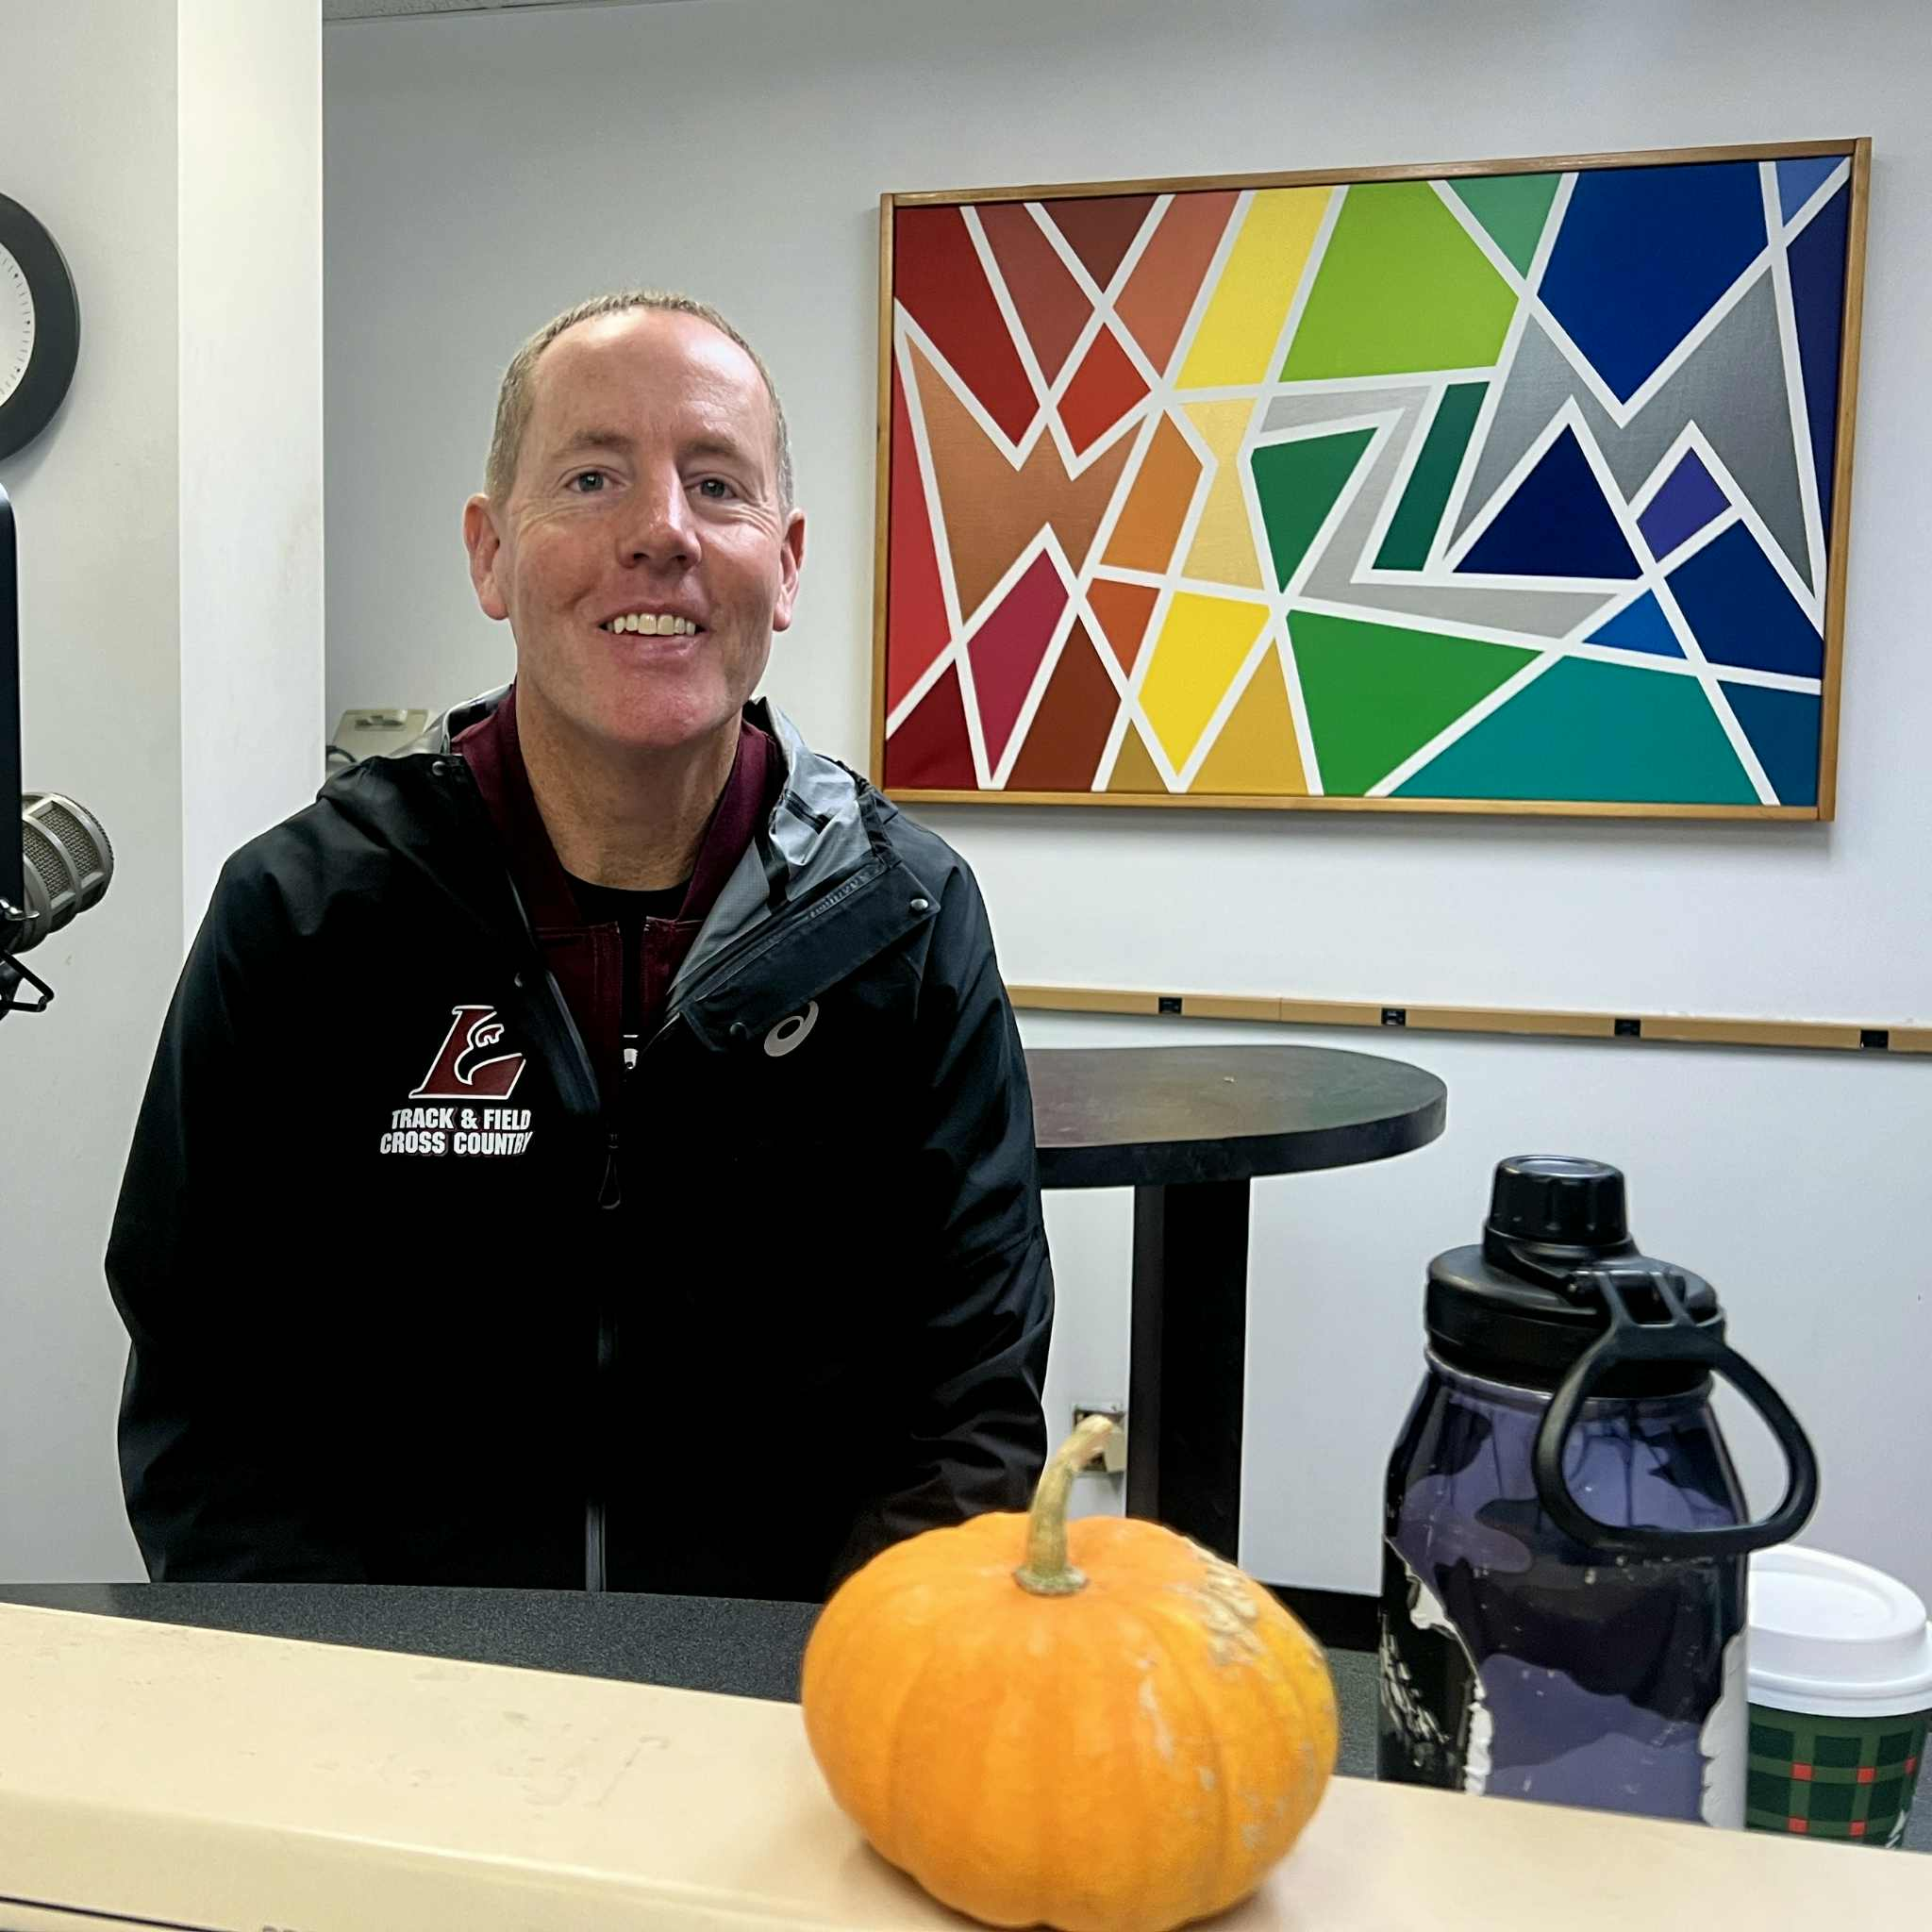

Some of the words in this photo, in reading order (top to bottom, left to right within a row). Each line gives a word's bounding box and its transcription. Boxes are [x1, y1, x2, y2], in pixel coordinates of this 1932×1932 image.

[391, 1108, 454, 1130] TRACK
[460, 1108, 478, 1130] &
[483, 1108, 532, 1130] FIELD
[379, 1131, 446, 1154] CROSS
[453, 1131, 534, 1155] COUNTRY
